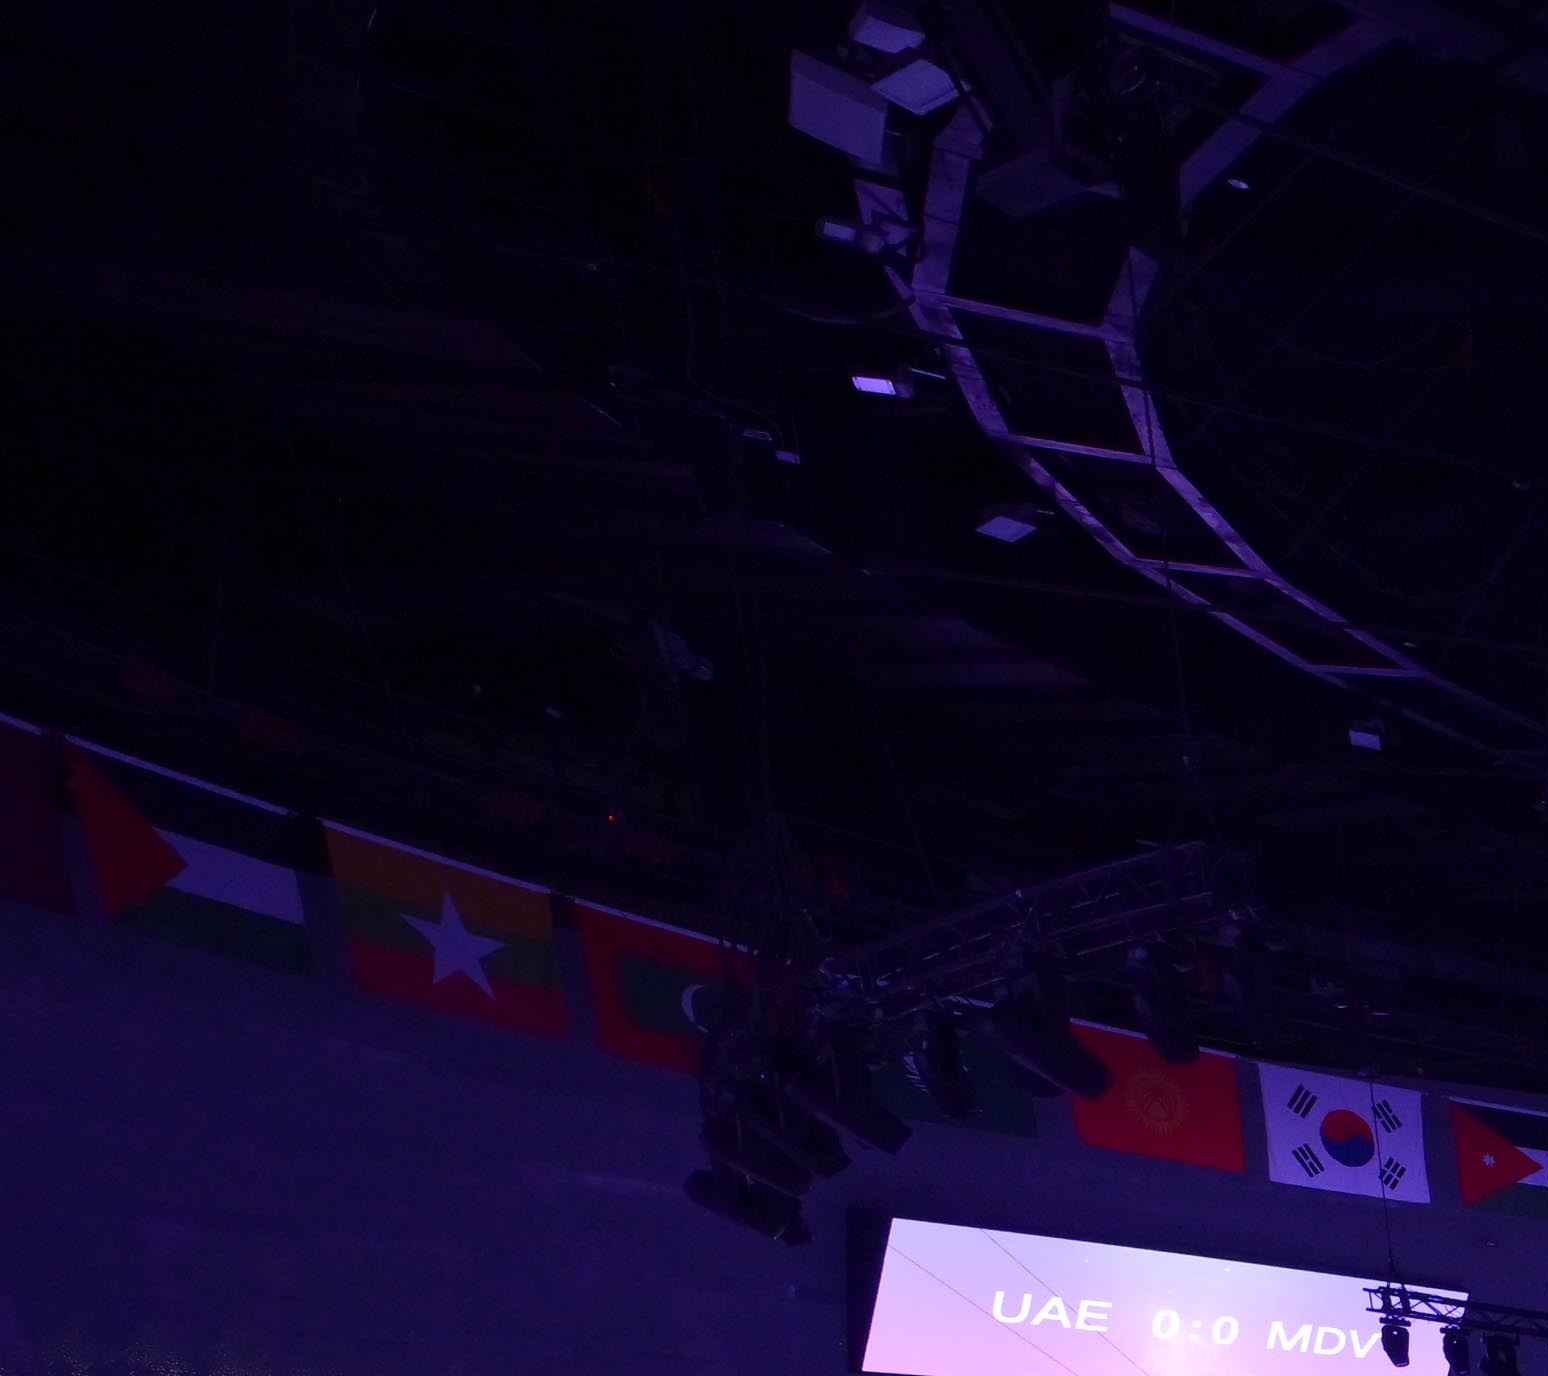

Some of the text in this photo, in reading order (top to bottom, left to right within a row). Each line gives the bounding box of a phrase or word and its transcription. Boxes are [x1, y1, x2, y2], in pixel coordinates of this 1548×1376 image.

[992, 1290, 1382, 1358] UAE 0:0 MDV
